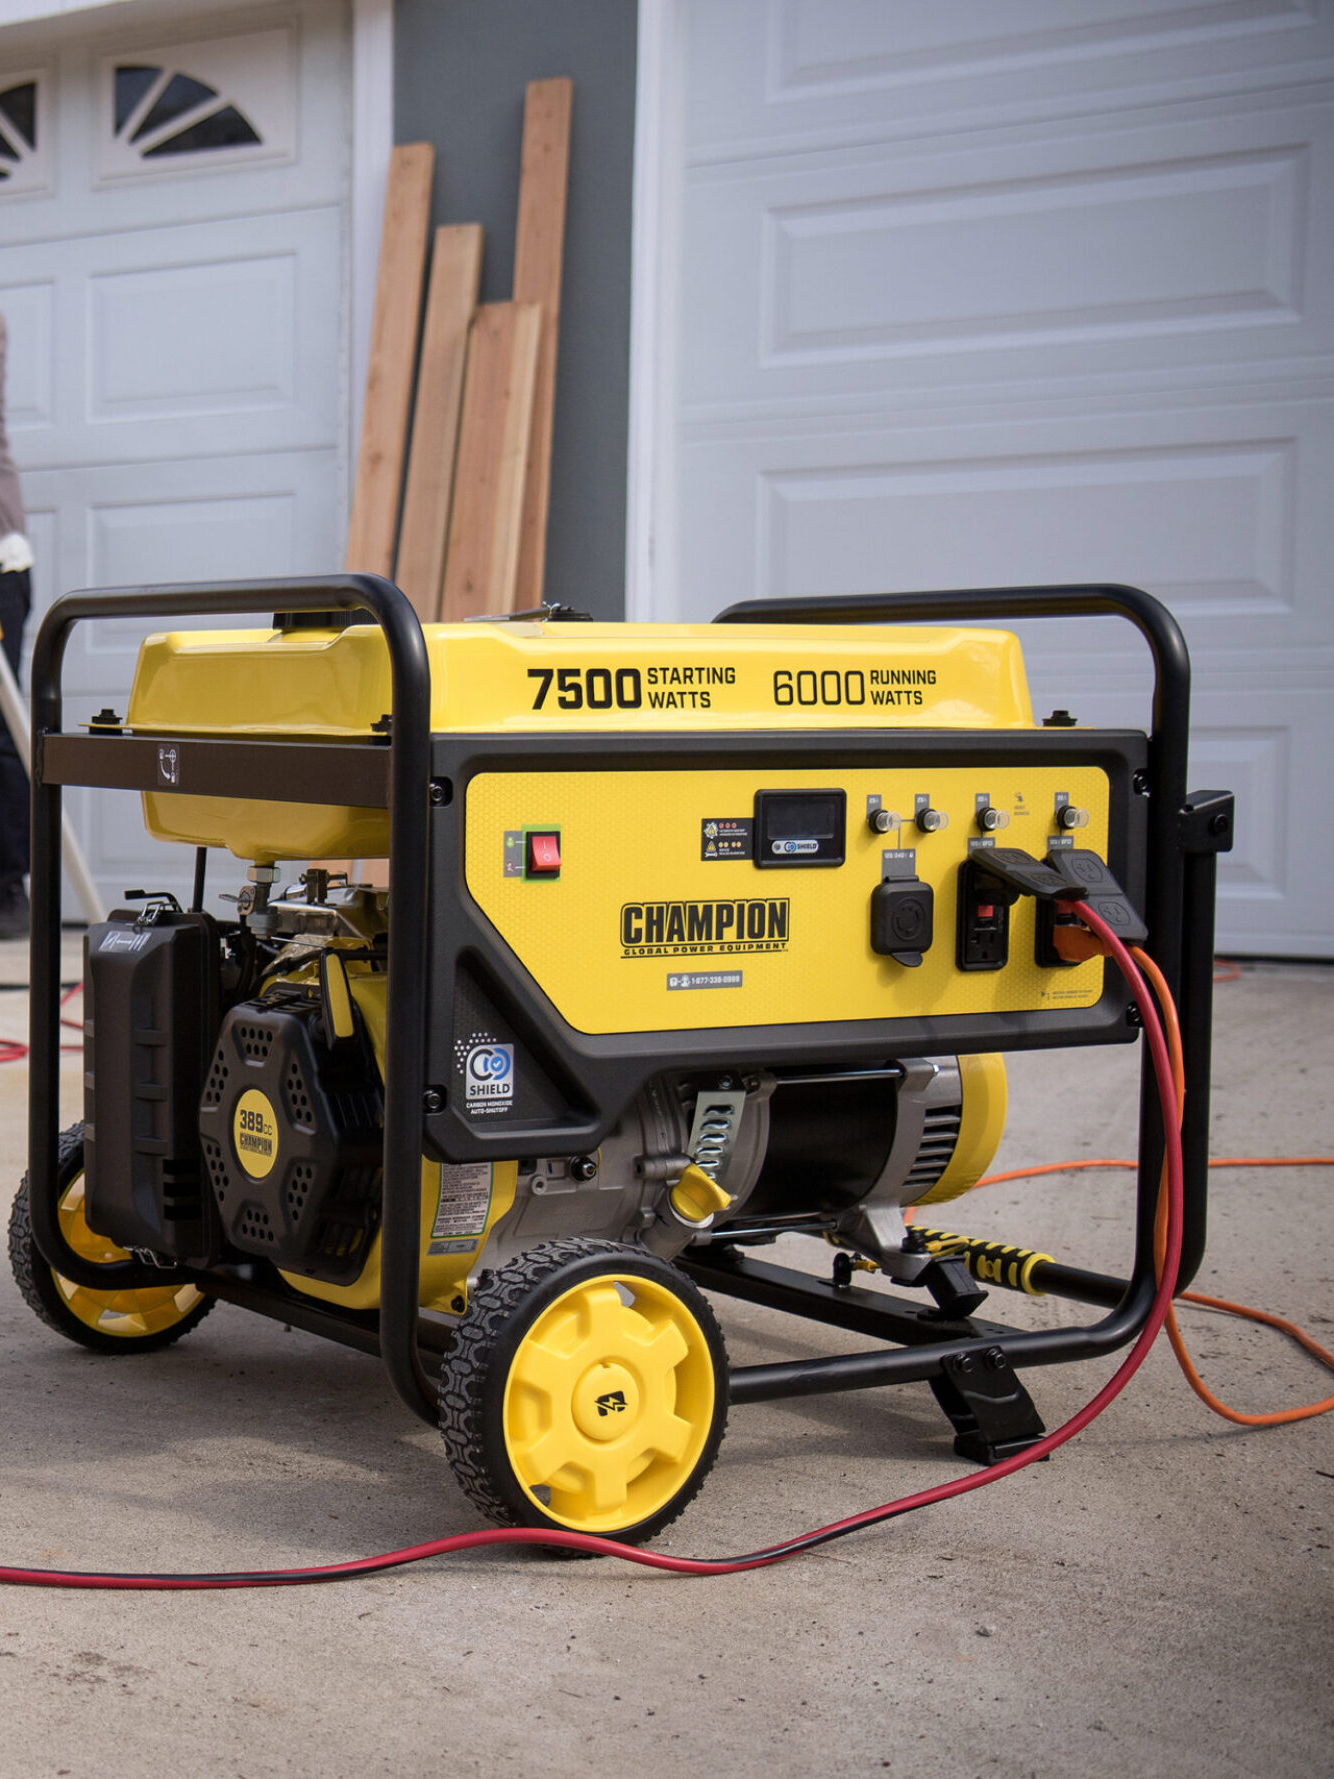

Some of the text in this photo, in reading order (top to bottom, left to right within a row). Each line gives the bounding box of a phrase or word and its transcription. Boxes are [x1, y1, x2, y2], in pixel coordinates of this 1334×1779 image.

[647, 667, 736, 685] STARTING
[870, 670, 937, 685] RUNNING
[527, 668, 642, 710] 7500
[773, 670, 865, 706] 6000
[648, 691, 711, 708] WATTS
[870, 690, 923, 705] WATTS
[623, 901, 787, 945] CHAMPION
[624, 942, 787, 956] GLOBAL POWER EQUIPMENT
[469, 1083, 511, 1096] SHIELD
[470, 1107, 508, 1115] AUTO-SHUTOFF
[239, 1132, 273, 1154] CHAMPION
